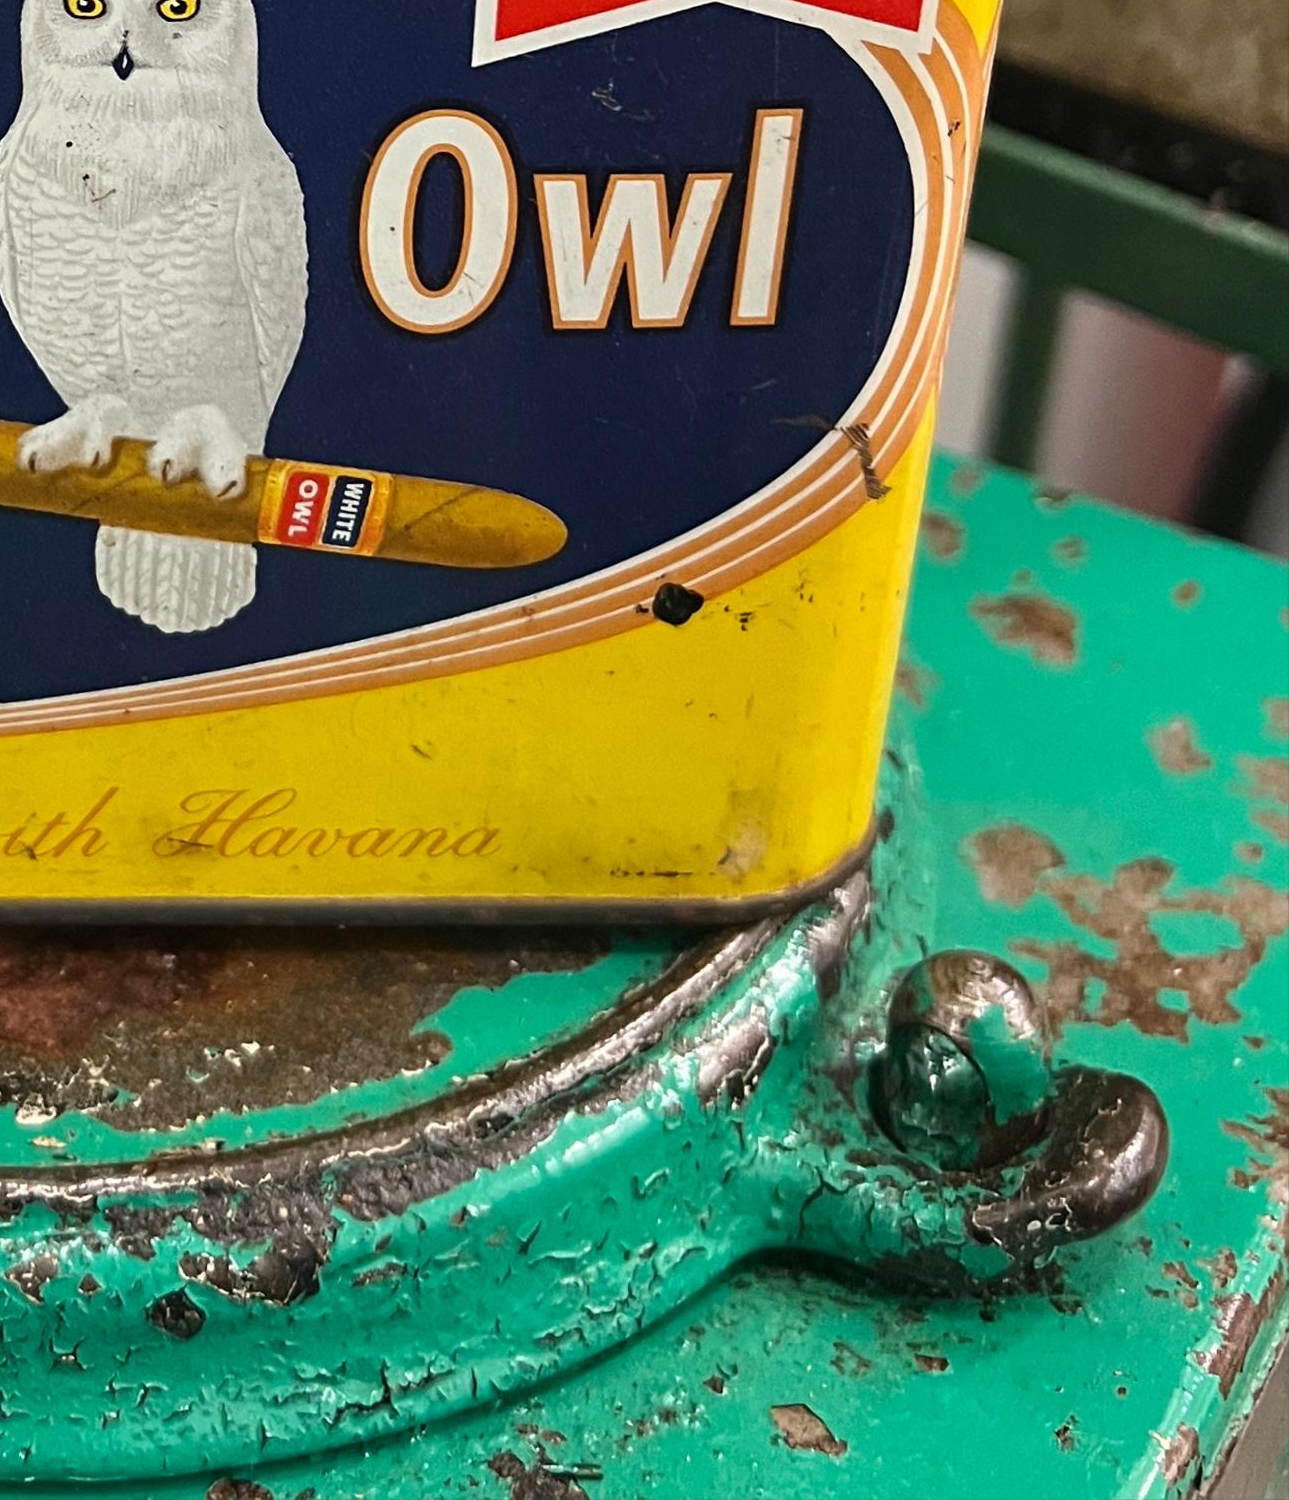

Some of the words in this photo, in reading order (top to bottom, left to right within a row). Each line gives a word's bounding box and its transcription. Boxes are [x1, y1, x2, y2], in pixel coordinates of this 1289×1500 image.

[357, 106, 804, 333] Owl
[287, 478, 319, 538] OWL
[331, 482, 365, 542] WHITE
[151, 786, 502, 860] Havana
